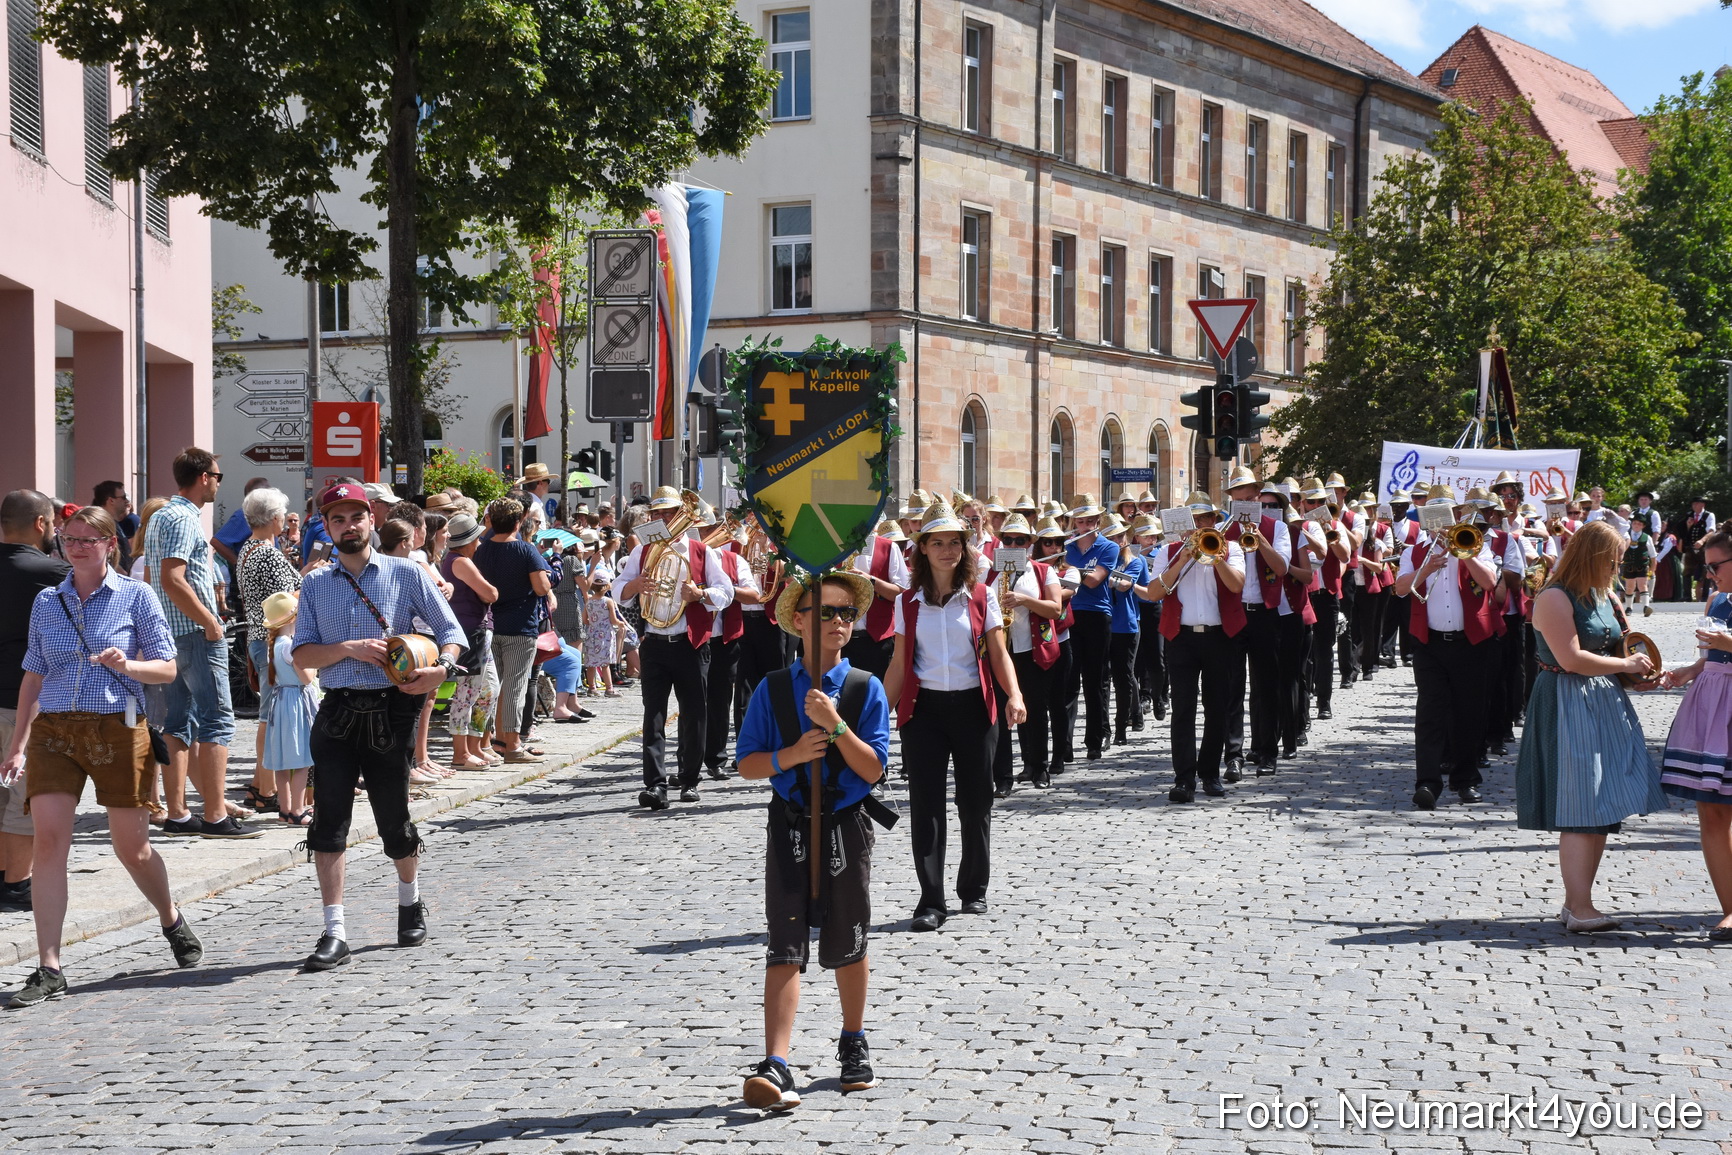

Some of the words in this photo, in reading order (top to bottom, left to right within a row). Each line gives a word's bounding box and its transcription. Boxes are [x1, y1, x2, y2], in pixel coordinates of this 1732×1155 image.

[612, 252, 634, 270] 30
[608, 283, 637, 293] ZONE
[607, 351, 636, 361] ZONE
[809, 381, 860, 394] Kapelle
[272, 422, 302, 436] AOK
[766, 437, 825, 477] Neumarkt
